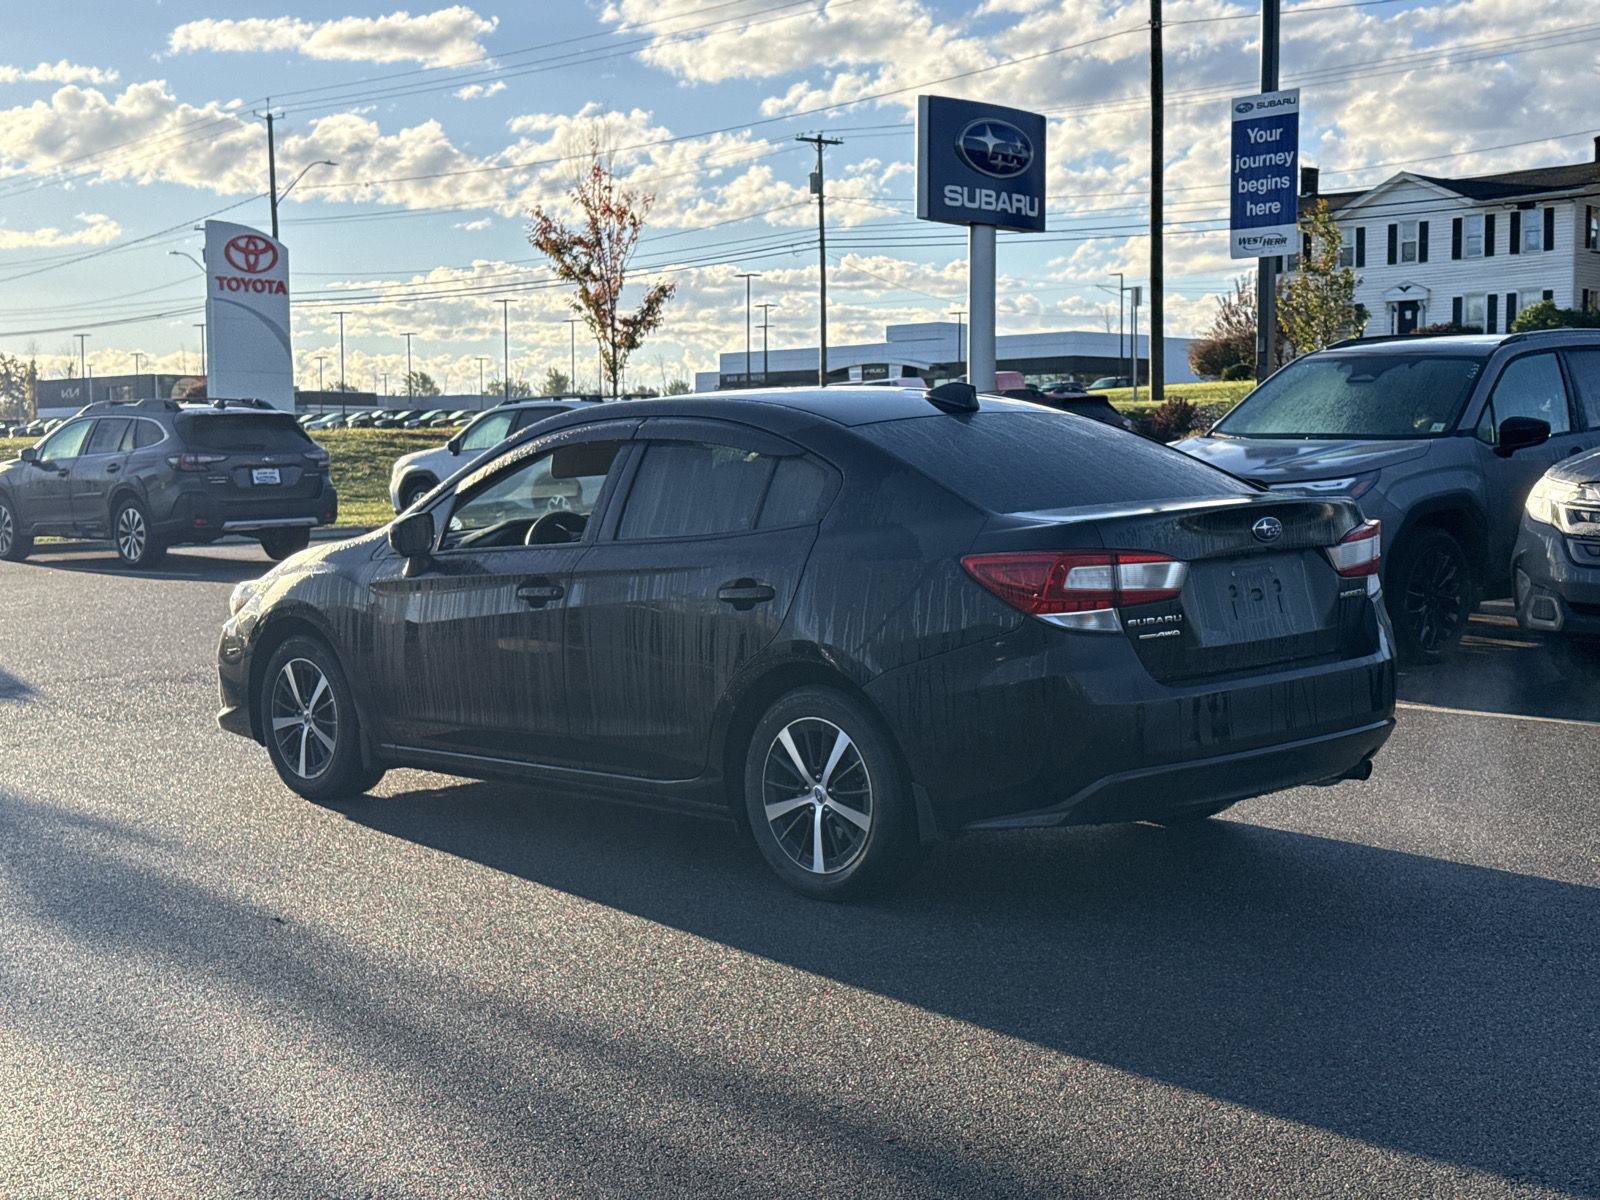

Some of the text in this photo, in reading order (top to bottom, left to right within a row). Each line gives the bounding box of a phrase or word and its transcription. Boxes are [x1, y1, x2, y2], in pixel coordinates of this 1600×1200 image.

[1256, 97, 1296, 109] SUBARU
[1247, 127, 1283, 144] Your
[1235, 150, 1294, 173] journey
[1238, 175, 1290, 195] begins
[944, 185, 1039, 217] SUBARU
[1246, 201, 1281, 217] here
[215, 276, 288, 295] TOYOTA
[1127, 614, 1182, 627] SUBARU
